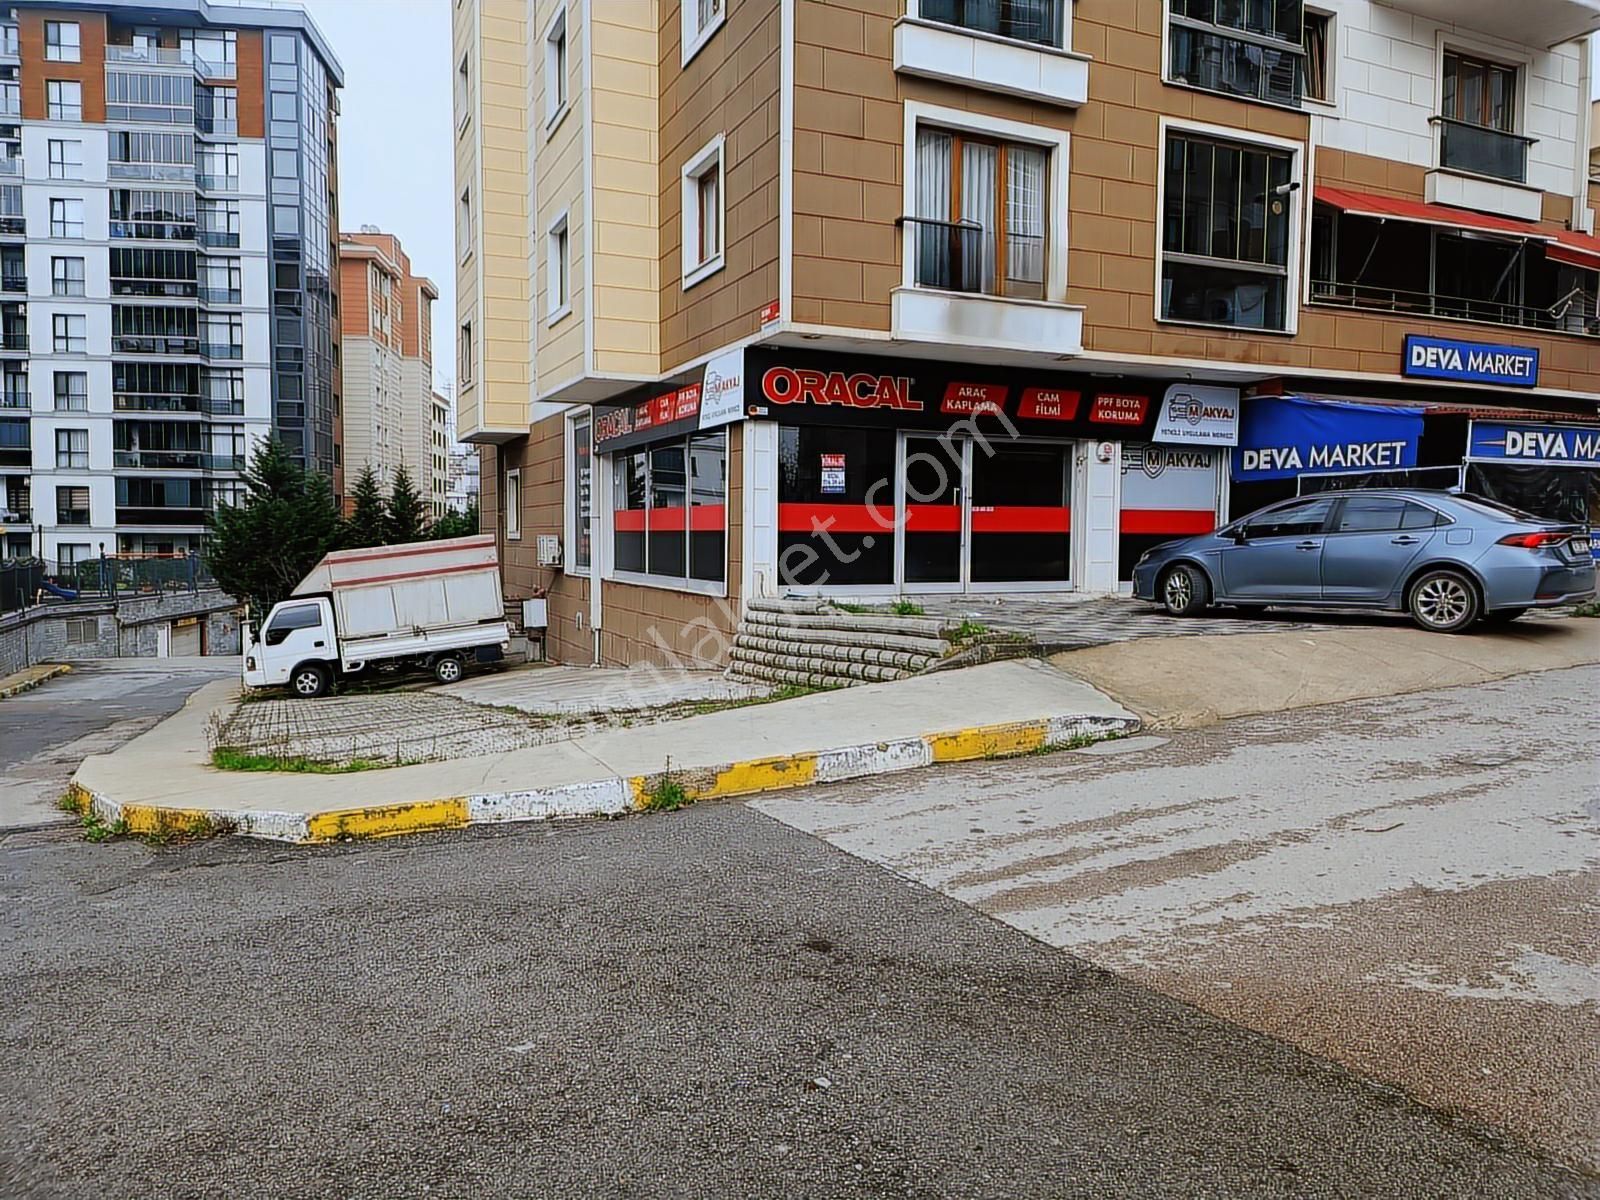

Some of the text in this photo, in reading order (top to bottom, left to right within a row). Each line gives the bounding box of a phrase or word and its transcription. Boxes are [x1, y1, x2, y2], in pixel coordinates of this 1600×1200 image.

[1411, 345, 1533, 377] DEVA MARKET
[762, 366, 924, 411] ORACAL
[958, 387, 987, 399] ARAÇ
[1037, 392, 1060, 403] CAM
[1097, 396, 1141, 410] PPF BOYA
[946, 399, 998, 413] KAPLAMA
[1188, 405, 1235, 419] MAKYAJ
[1097, 409, 1140, 422] KORUMA
[1505, 431, 1568, 458] DEVA
[1147, 452, 1212, 468] MAKYAJ
[1243, 441, 1406, 470] DEVA MARKET
